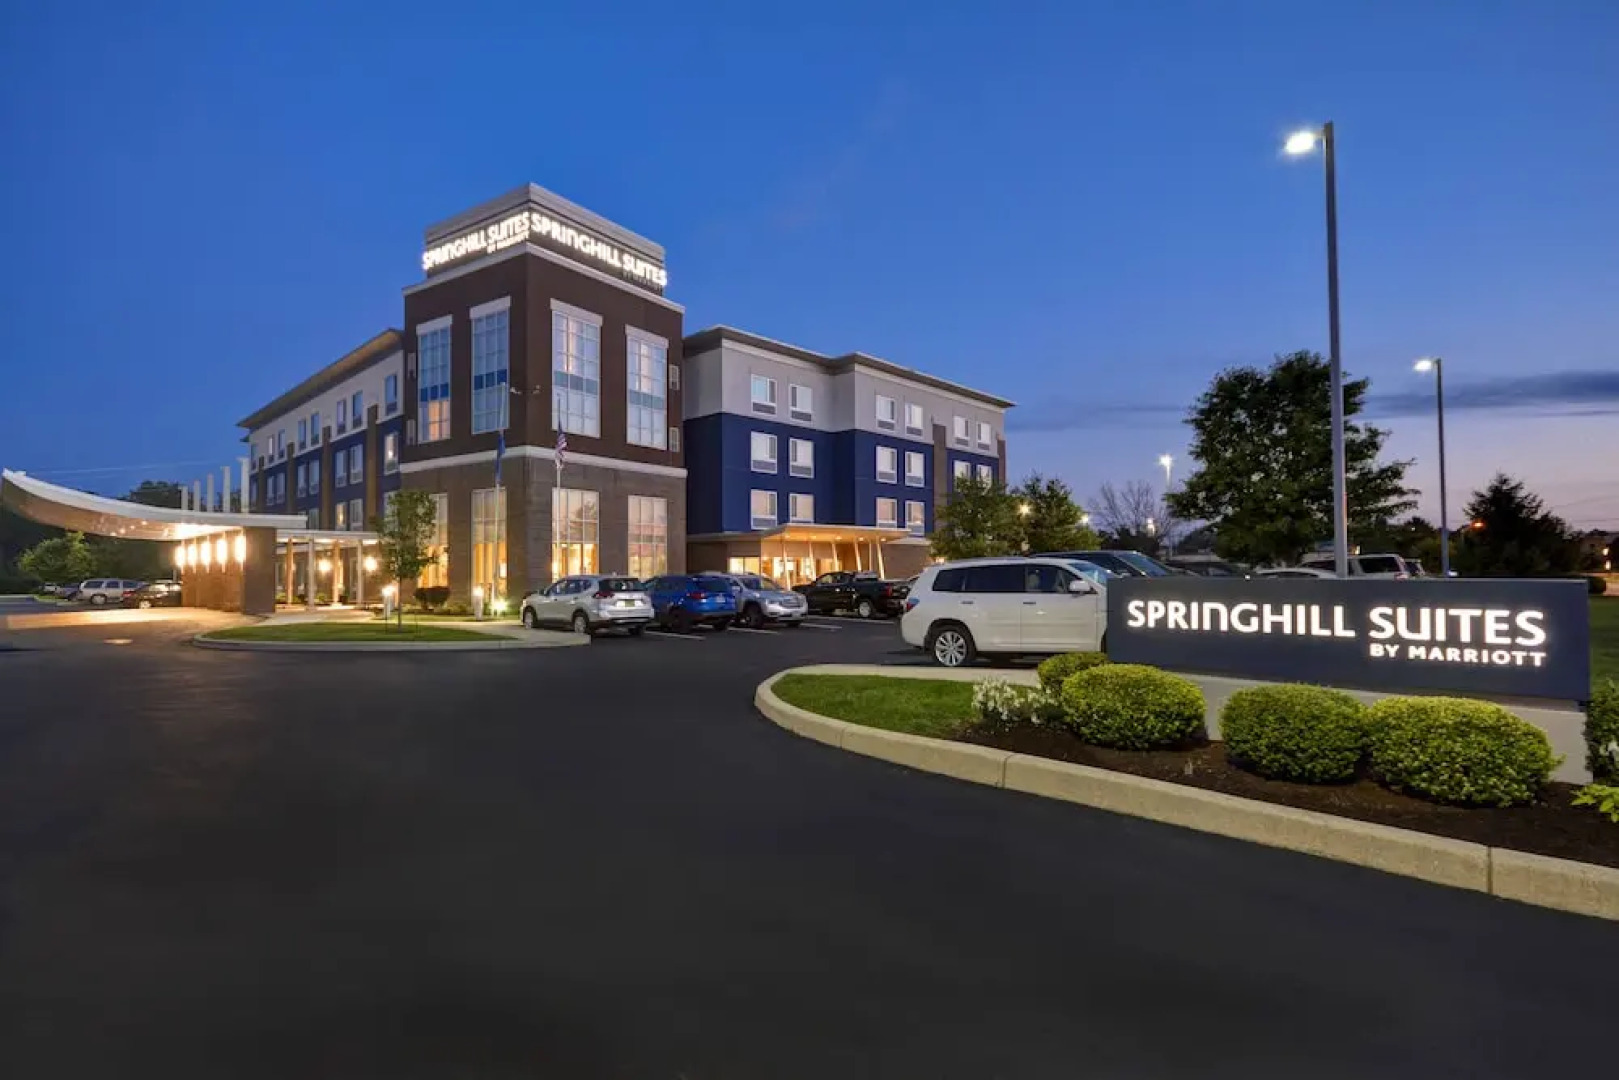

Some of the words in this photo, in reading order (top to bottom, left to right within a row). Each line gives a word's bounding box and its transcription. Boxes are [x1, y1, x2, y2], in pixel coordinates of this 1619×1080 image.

[486, 211, 530, 243] SUITES
[530, 212, 622, 268] SPRINGHILL
[622, 253, 667, 286] SUITES
[1127, 600, 1355, 637] SPRINGHILL
[1369, 606, 1546, 646] SUITES
[1370, 643, 1399, 658] BY
[1408, 645, 1546, 667] MARRIOTT
